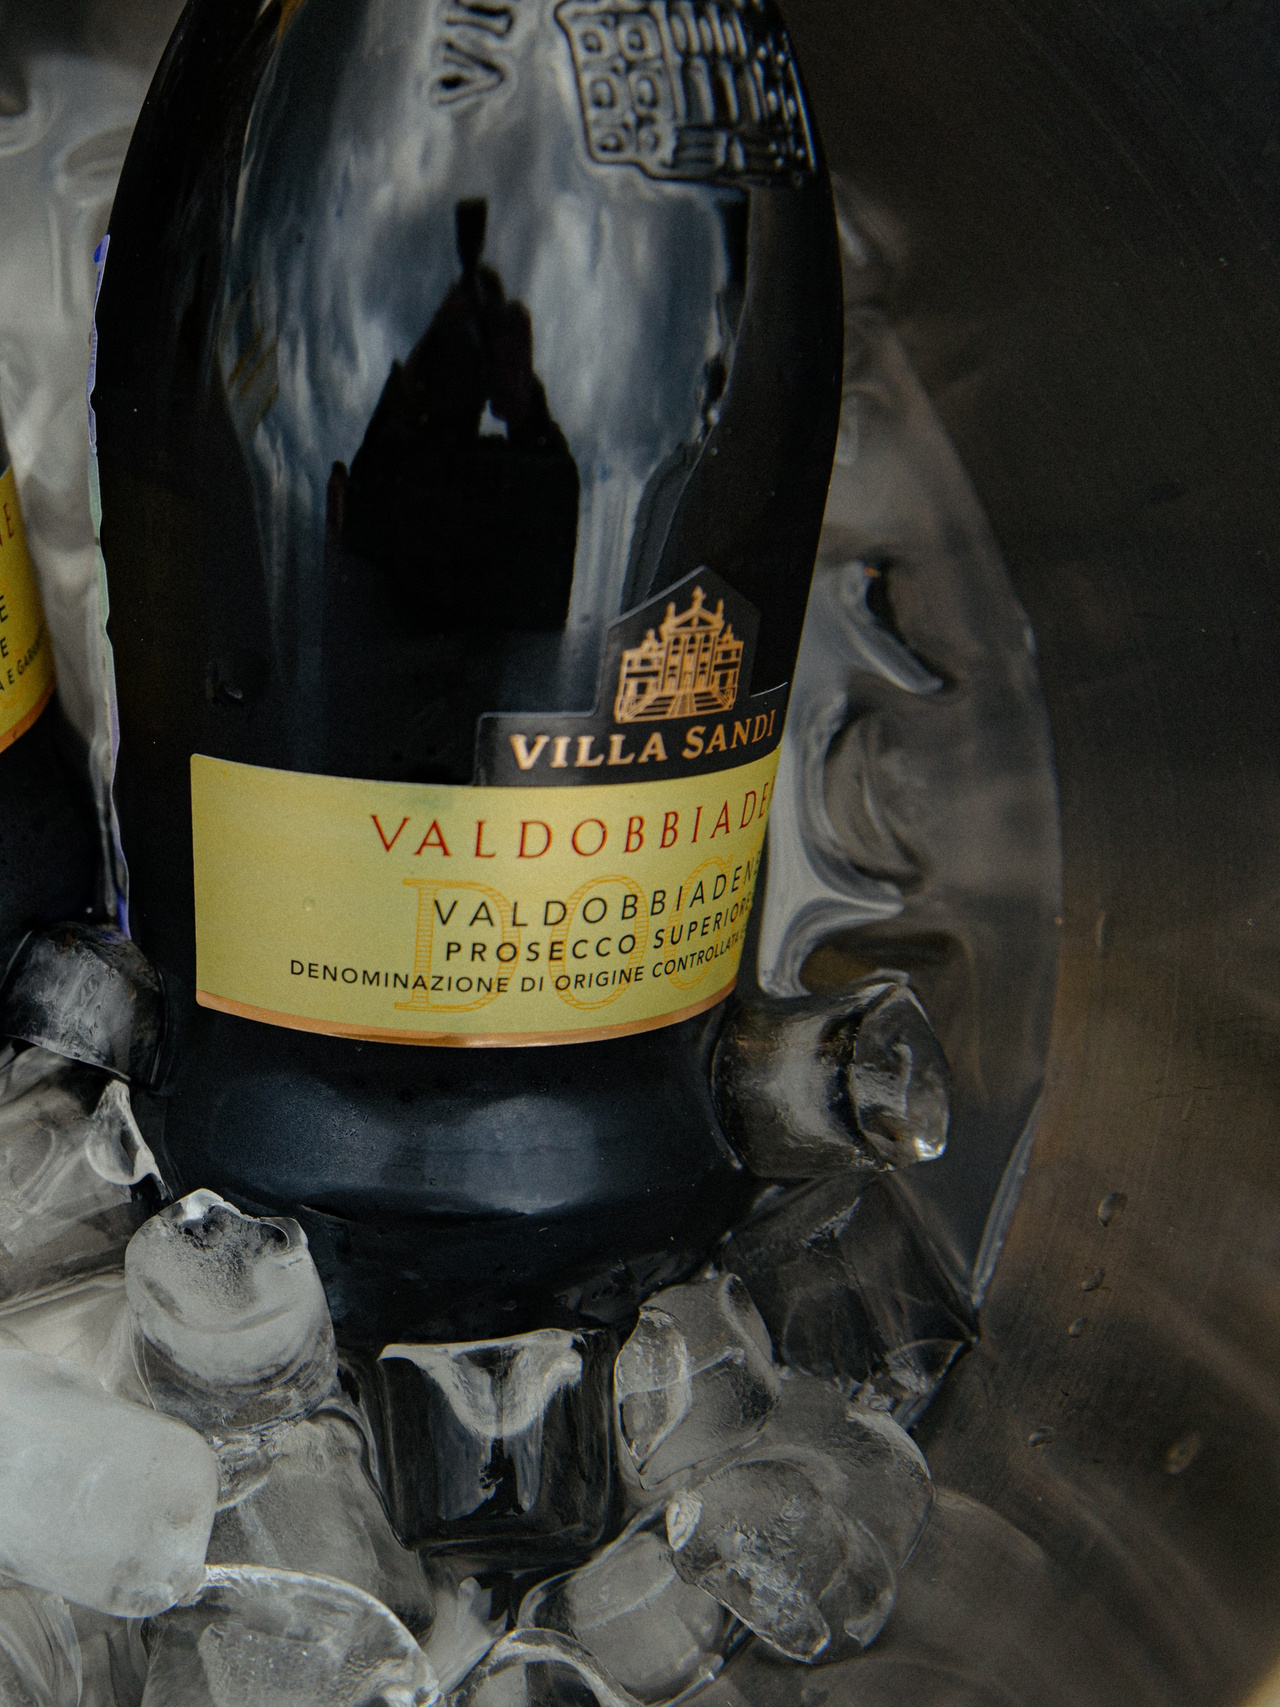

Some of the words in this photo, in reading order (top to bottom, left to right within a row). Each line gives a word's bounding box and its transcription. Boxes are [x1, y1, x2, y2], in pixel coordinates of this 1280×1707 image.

[509, 732, 668, 770] VILLA
[682, 709, 777, 760] SANDI
[370, 776, 776, 859] VALDOBBIADE
[445, 934, 636, 962] PROSECCO
[653, 891, 752, 949] SUPERIORE
[291, 959, 509, 993] DENOMINAZIONE
[521, 976, 544, 992] DI
[555, 966, 644, 992] ORIGINE
[652, 930, 739, 978] CONTROLLATA
